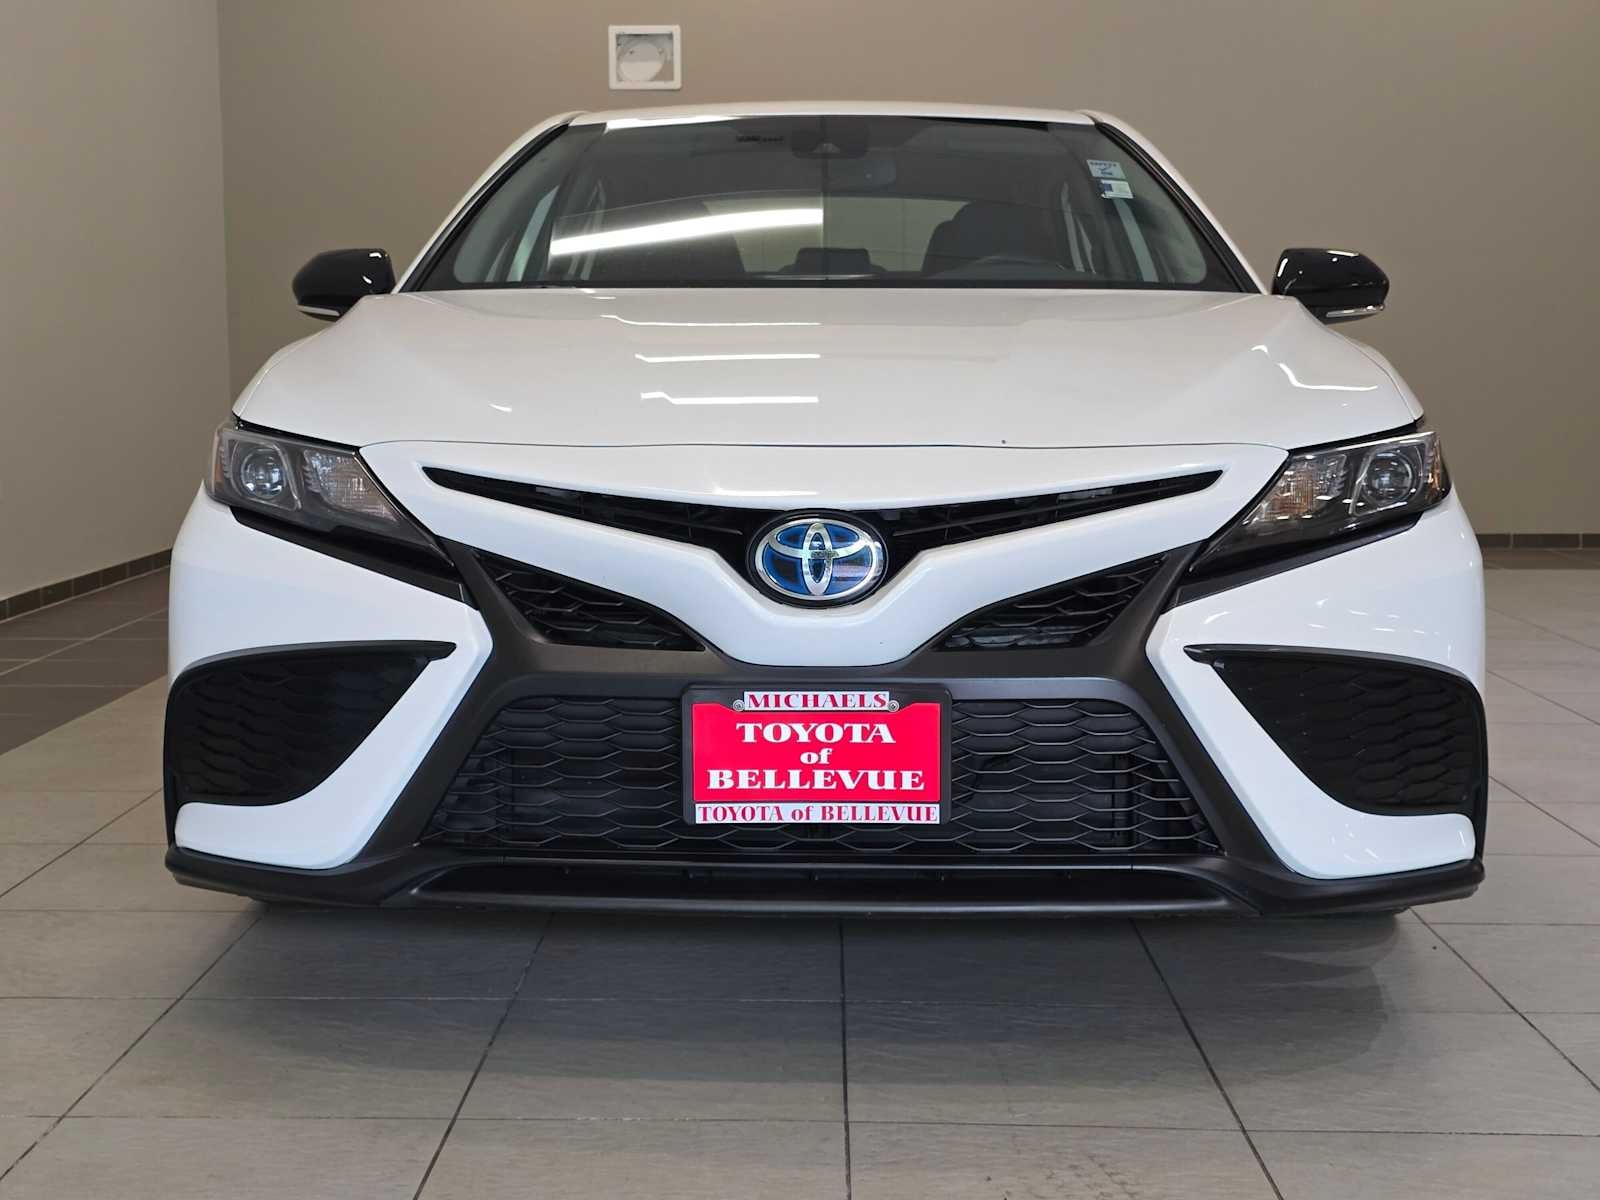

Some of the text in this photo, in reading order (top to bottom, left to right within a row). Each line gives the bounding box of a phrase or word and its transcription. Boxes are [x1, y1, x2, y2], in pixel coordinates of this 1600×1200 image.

[747, 694, 887, 708] MICHAELS
[736, 723, 896, 743] TOYOTA
[800, 748, 832, 764] of
[707, 769, 925, 790] BELLEVUE
[698, 805, 938, 822] TOYOTA of BELLEVUE
